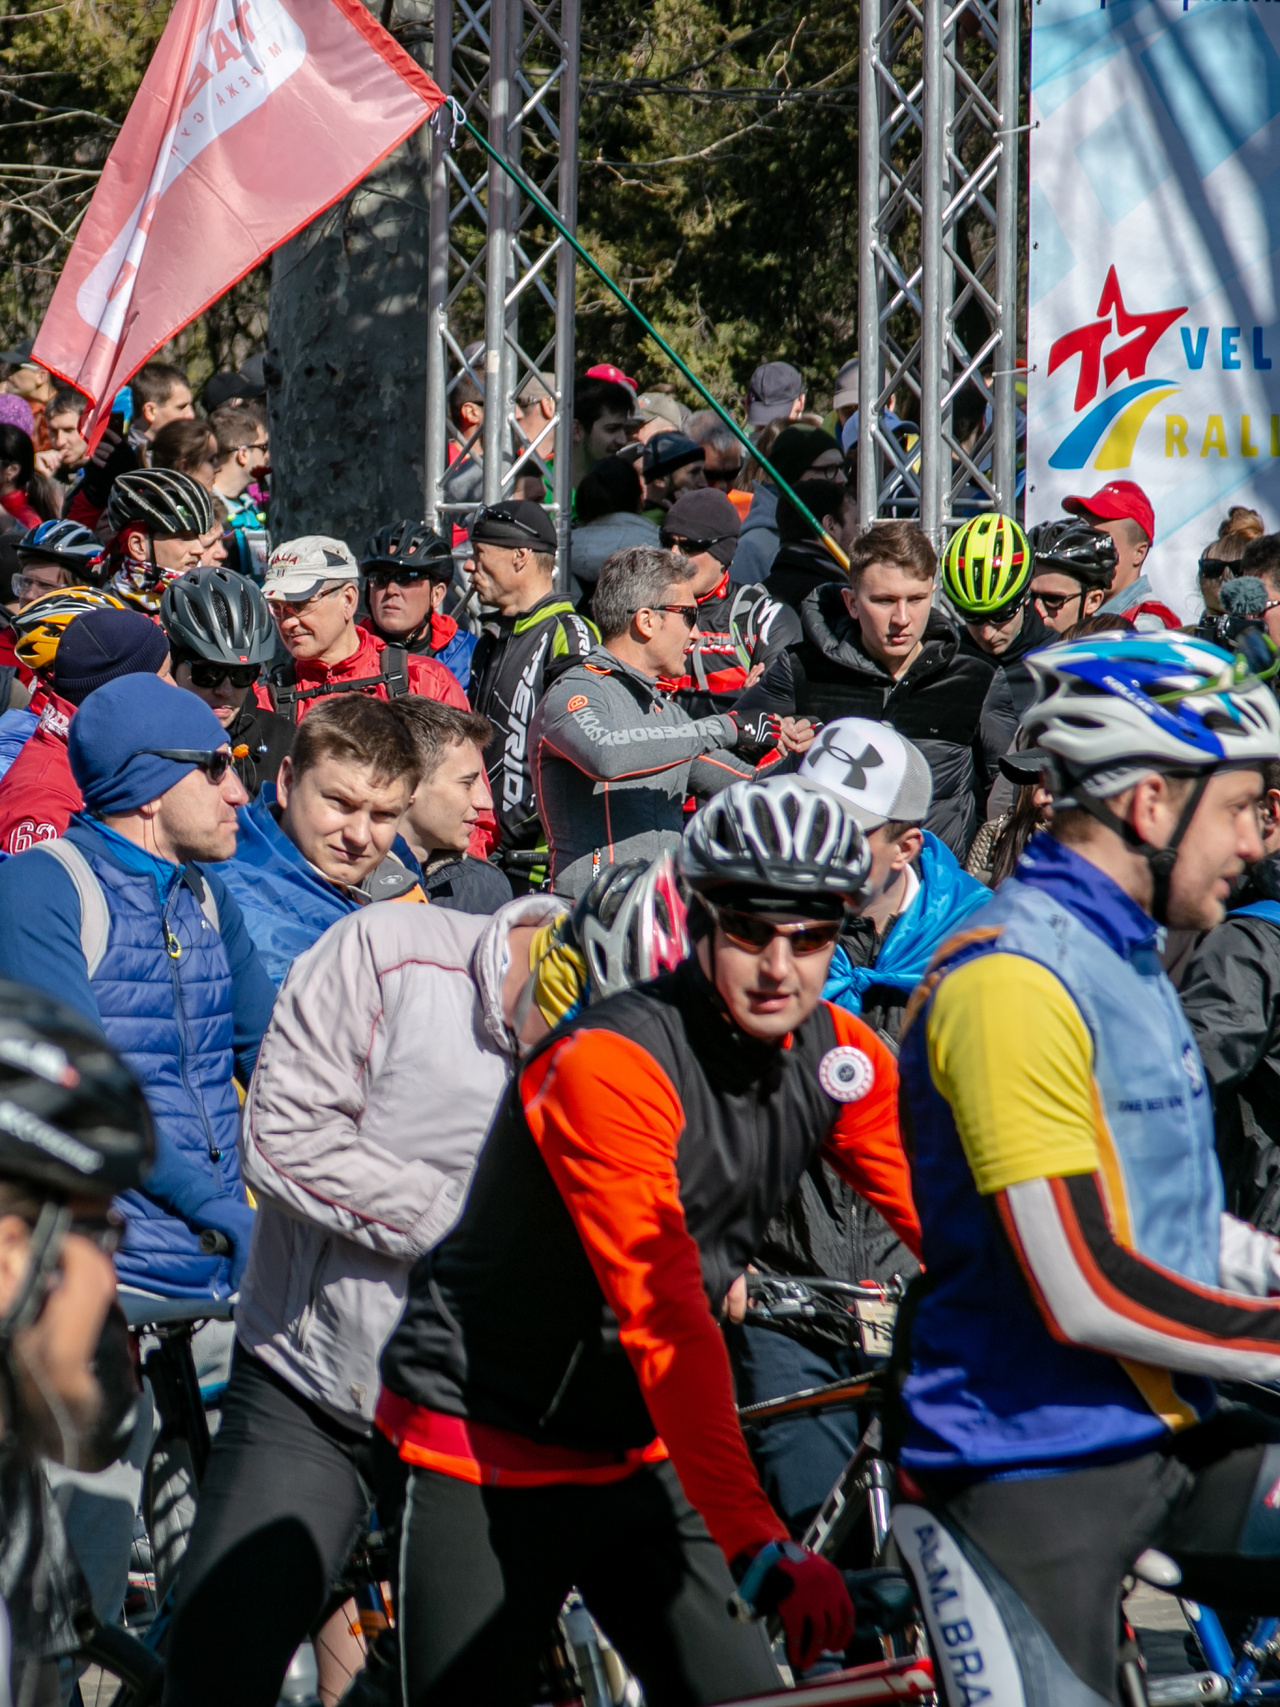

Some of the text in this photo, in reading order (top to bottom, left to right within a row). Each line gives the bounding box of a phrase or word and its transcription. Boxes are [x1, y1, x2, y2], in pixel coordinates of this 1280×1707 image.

[1180, 326, 1273, 370] VEL
[567, 614, 591, 656] MERI
[572, 706, 609, 742] SPORT
[597, 719, 723, 746] SUPERDRY
